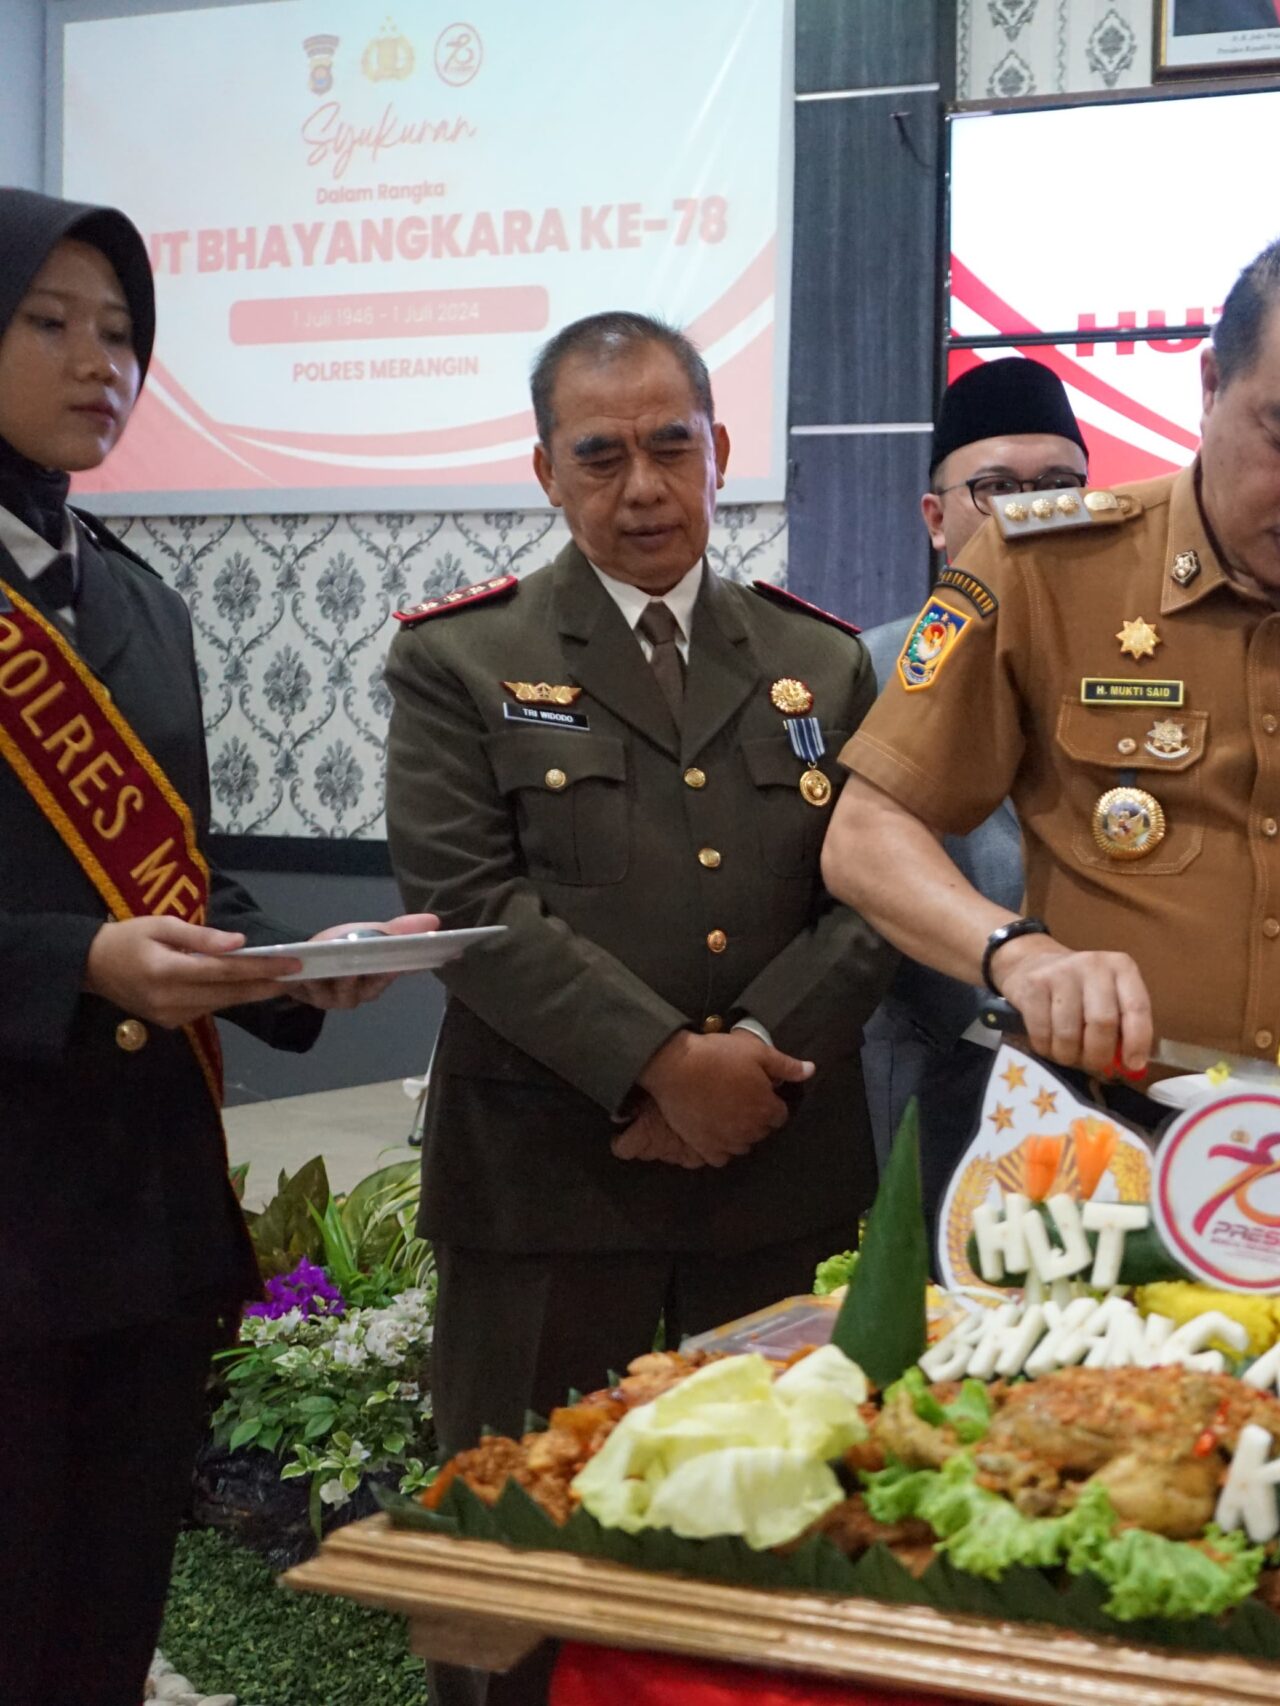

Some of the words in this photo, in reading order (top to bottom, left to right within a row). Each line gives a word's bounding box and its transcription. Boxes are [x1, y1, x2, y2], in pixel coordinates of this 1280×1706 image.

[301, 100, 478, 180] Syukuran
[315, 184, 373, 205] Dalam
[377, 180, 447, 205] Rangka
[196, 207, 571, 274] BHAYANGKARA
[579, 194, 729, 252] KE-78
[303, 308, 333, 329] Juli
[336, 305, 375, 326] 1946
[404, 304, 434, 324] Juli
[437, 302, 481, 322] 2024
[291, 360, 366, 383] POLRES
[369, 355, 480, 380] MERANGIN
[1110, 685, 1143, 697] MUKTI
[1146, 687, 1170, 697] SAID
[521, 707, 538, 717] TRI
[540, 711, 574, 723] WIDODO
[972, 1192, 1149, 1290] HUT
